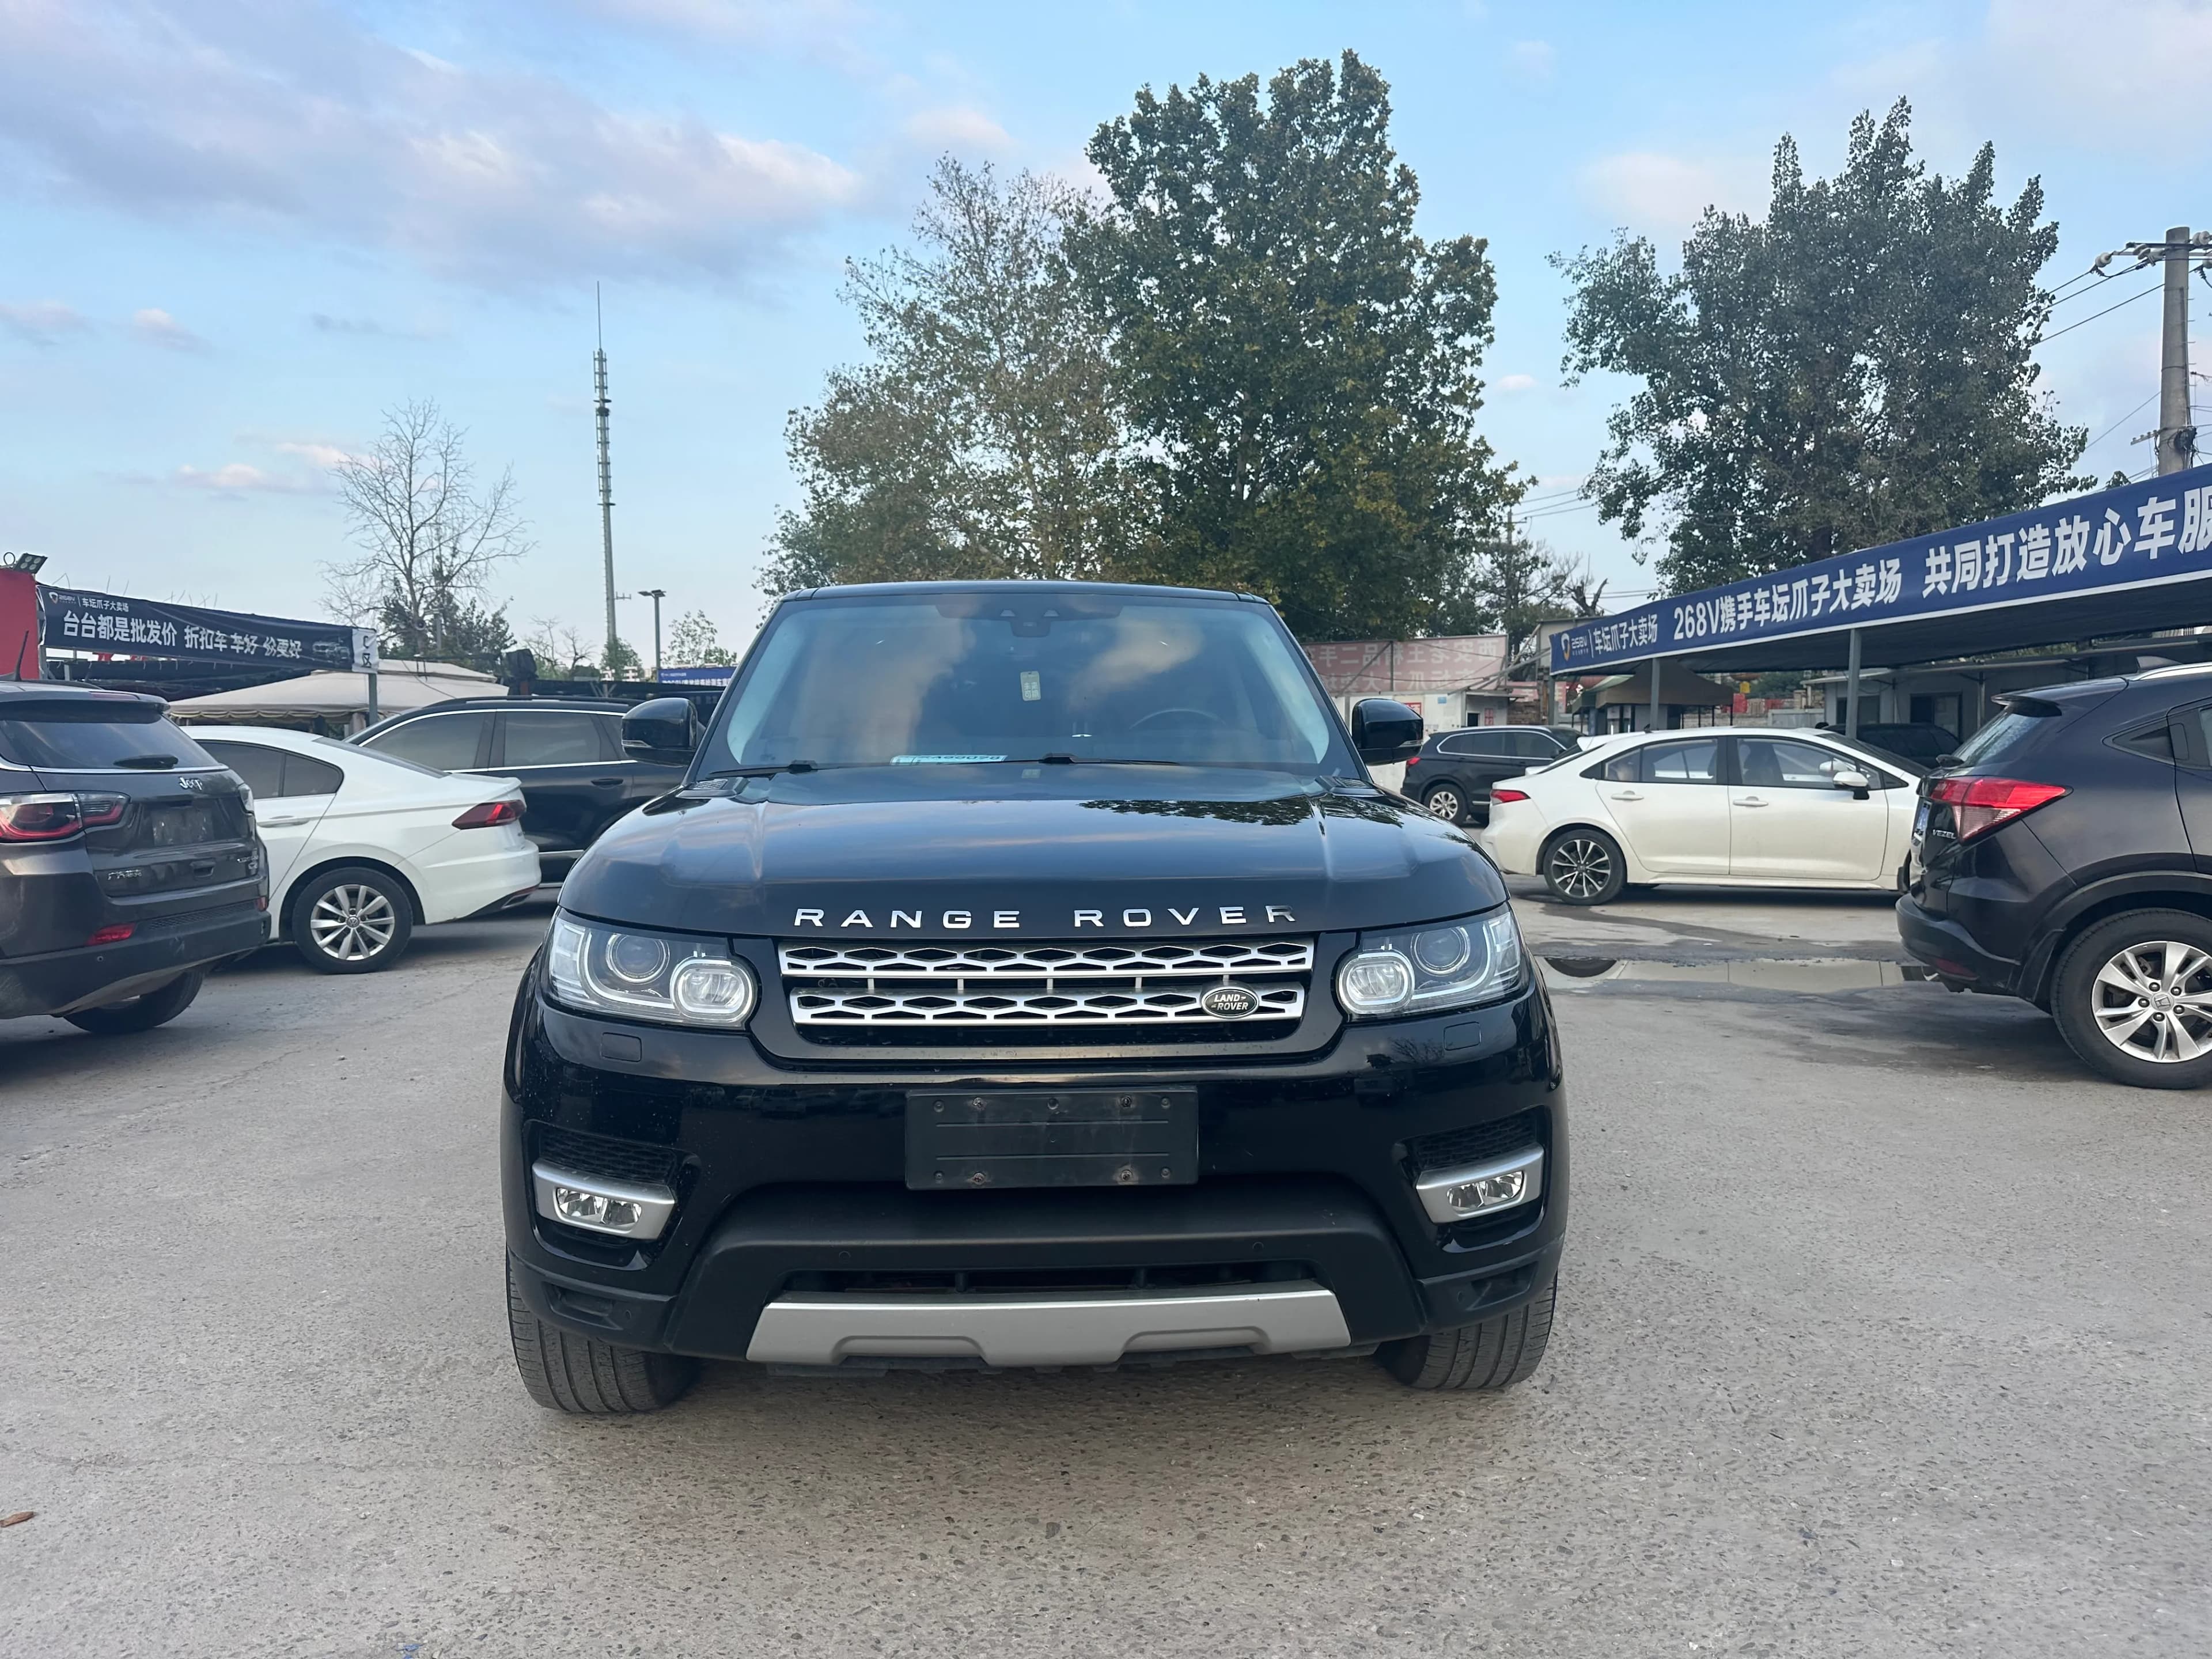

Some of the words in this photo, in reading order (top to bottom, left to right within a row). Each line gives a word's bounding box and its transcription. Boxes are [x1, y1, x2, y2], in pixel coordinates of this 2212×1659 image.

[1922, 486, 2212, 599] 共同打造放心车服
[63, 609, 177, 646] 台台都是批发价
[1932, 829, 1956, 839] VEZEL
[794, 908, 1020, 929] RANGE
[1073, 905, 1296, 928] ROVER
[1214, 994, 1240, 1002] LAND
[1216, 1002, 1249, 1010] ROVER
